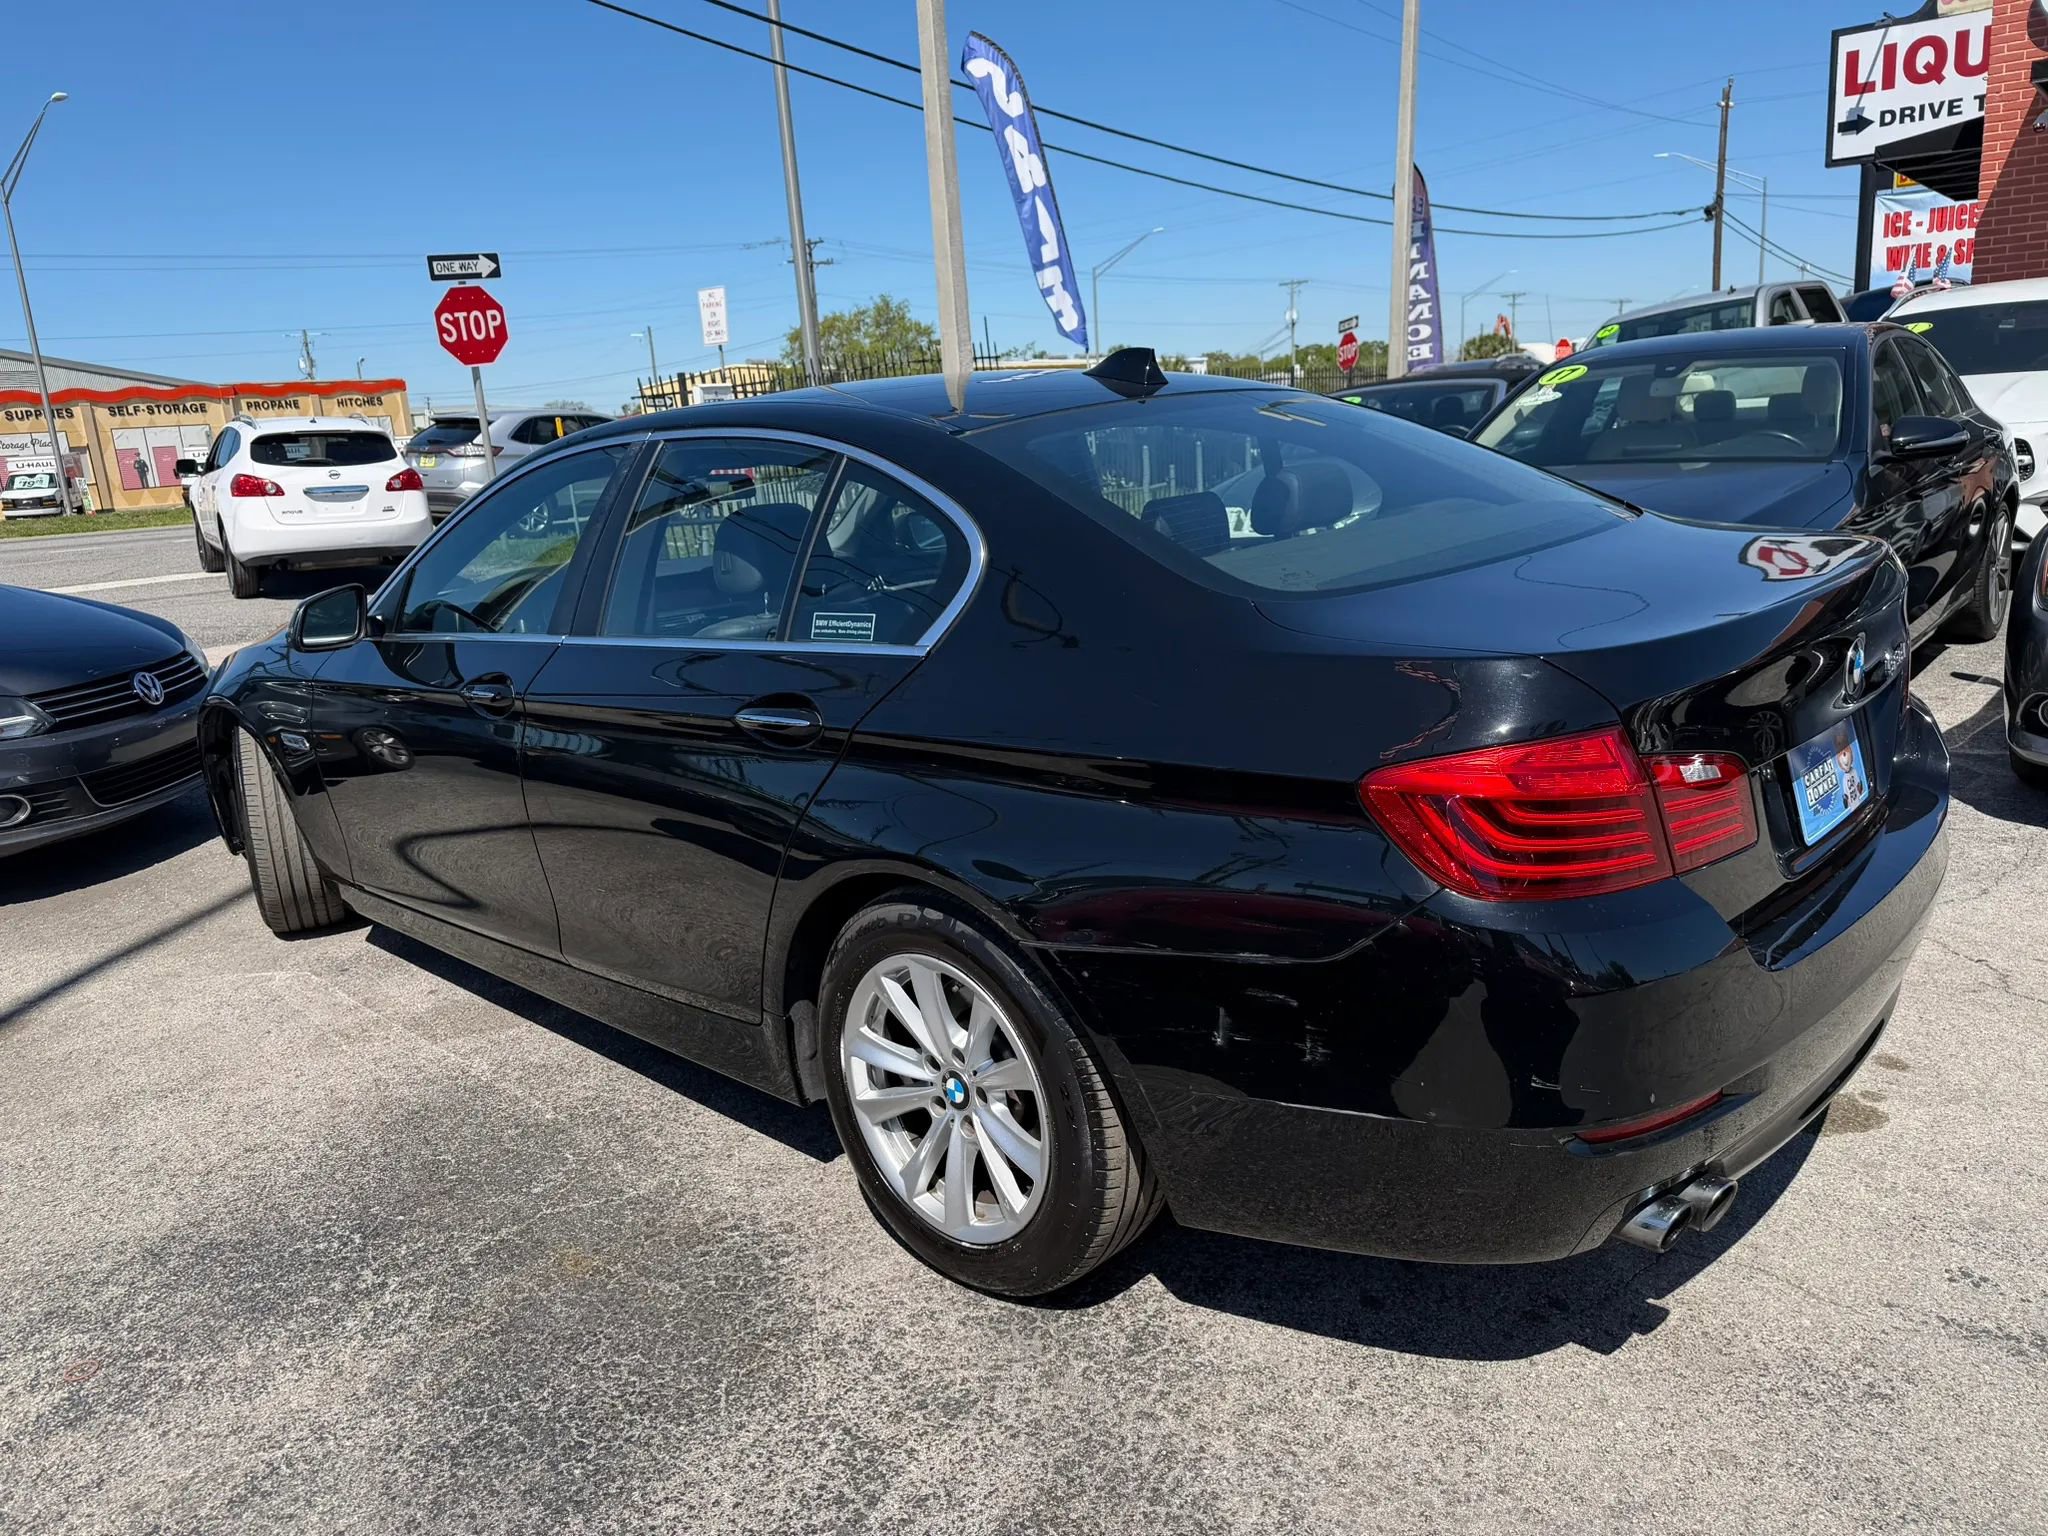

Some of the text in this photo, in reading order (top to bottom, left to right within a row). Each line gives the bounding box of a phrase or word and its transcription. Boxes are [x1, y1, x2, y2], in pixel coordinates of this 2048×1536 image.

[1879, 98, 1963, 127] DRIVE
[1883, 211, 1912, 239] ICE
[435, 261, 479, 273] ONE WAY
[440, 309, 501, 343] STOP
[246, 399, 300, 411] PROPANE
[337, 396, 383, 408] HITCHES
[108, 403, 207, 417] SELF-STORAGE
[16, 461, 55, 469] U-HAUL
